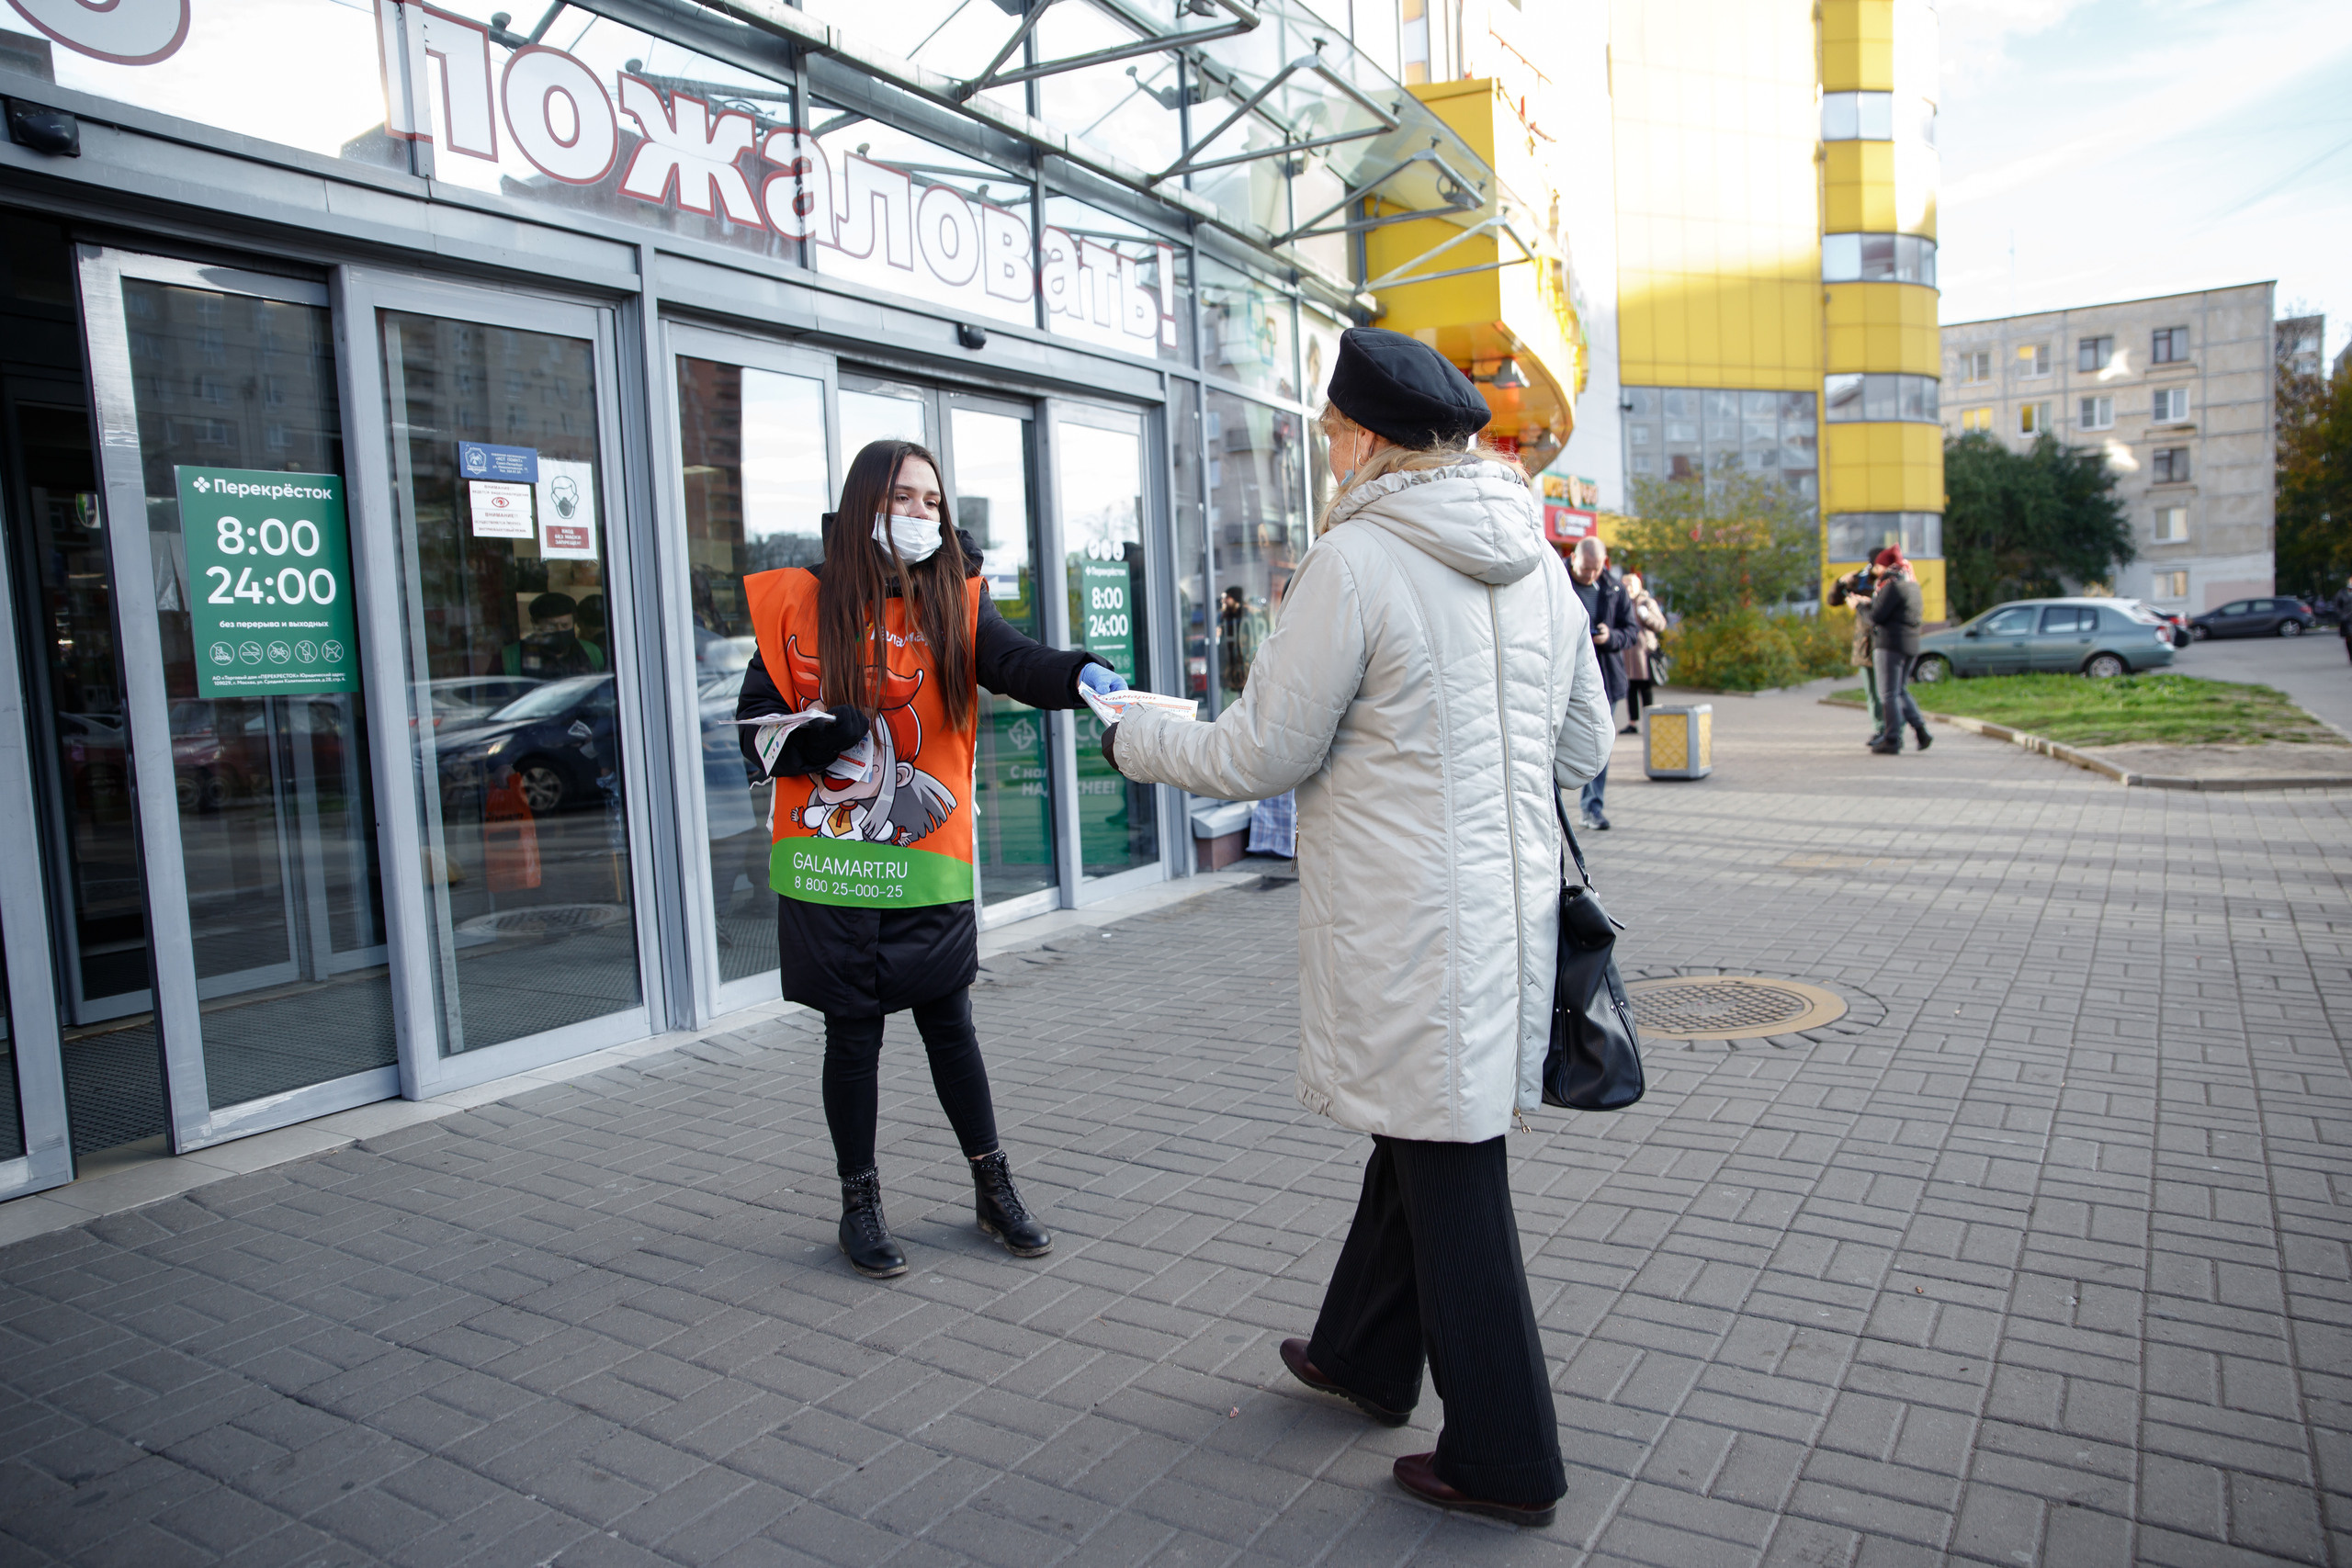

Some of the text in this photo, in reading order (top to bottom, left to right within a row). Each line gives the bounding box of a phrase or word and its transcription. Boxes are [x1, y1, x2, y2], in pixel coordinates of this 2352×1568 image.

[213, 478, 333, 500] Перекрёсток
[217, 515, 321, 557] 8:00
[206, 566, 336, 604] 24:00
[1091, 586, 1124, 609] 8:00
[236, 621, 280, 629] перерыва
[1089, 614, 1128, 637] 24:00
[1011, 765, 1020, 779] С
[793, 852, 908, 879] GALAMART.RU
[794, 875, 903, 898] 8 800 25-000-25
